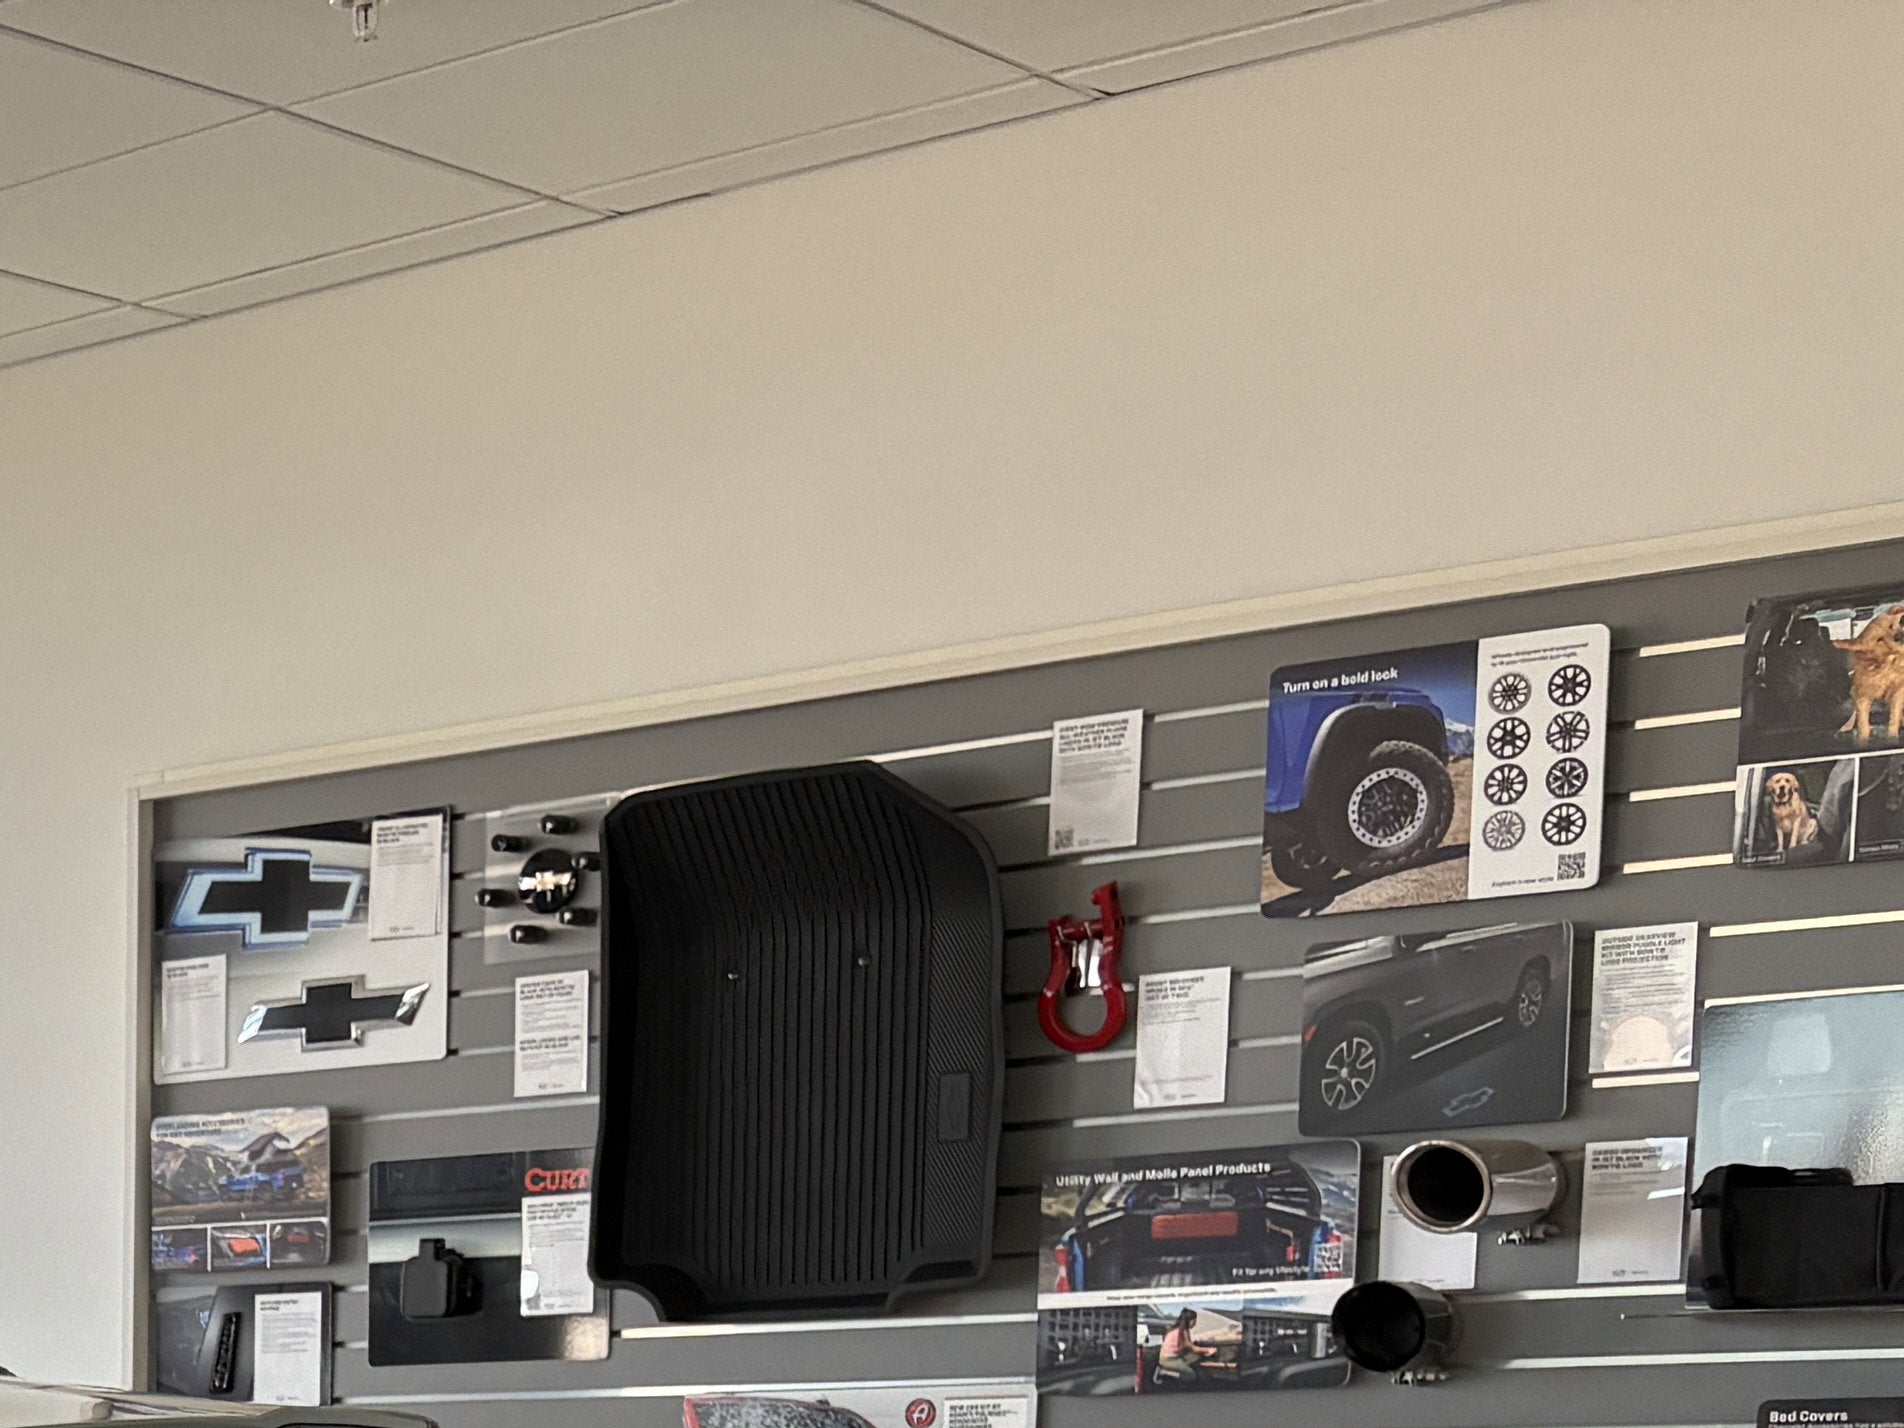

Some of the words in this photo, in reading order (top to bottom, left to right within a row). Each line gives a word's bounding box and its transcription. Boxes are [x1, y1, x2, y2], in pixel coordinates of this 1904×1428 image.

[1282, 681, 1310, 694] Turn
[1312, 679, 1328, 690] on
[1331, 677, 1339, 688] a
[1341, 670, 1369, 686] bold
[1371, 667, 1398, 682] look
[524, 1168, 591, 1193] CURT
[1056, 1174, 1091, 1188] Utility
[1093, 1171, 1119, 1185] Wall
[1121, 1169, 1144, 1183] and
[1180, 1165, 1214, 1178] Panel
[1215, 1162, 1271, 1177] Products
[1769, 1411, 1797, 1423] Bed
[1799, 1410, 1848, 1422] Covers
